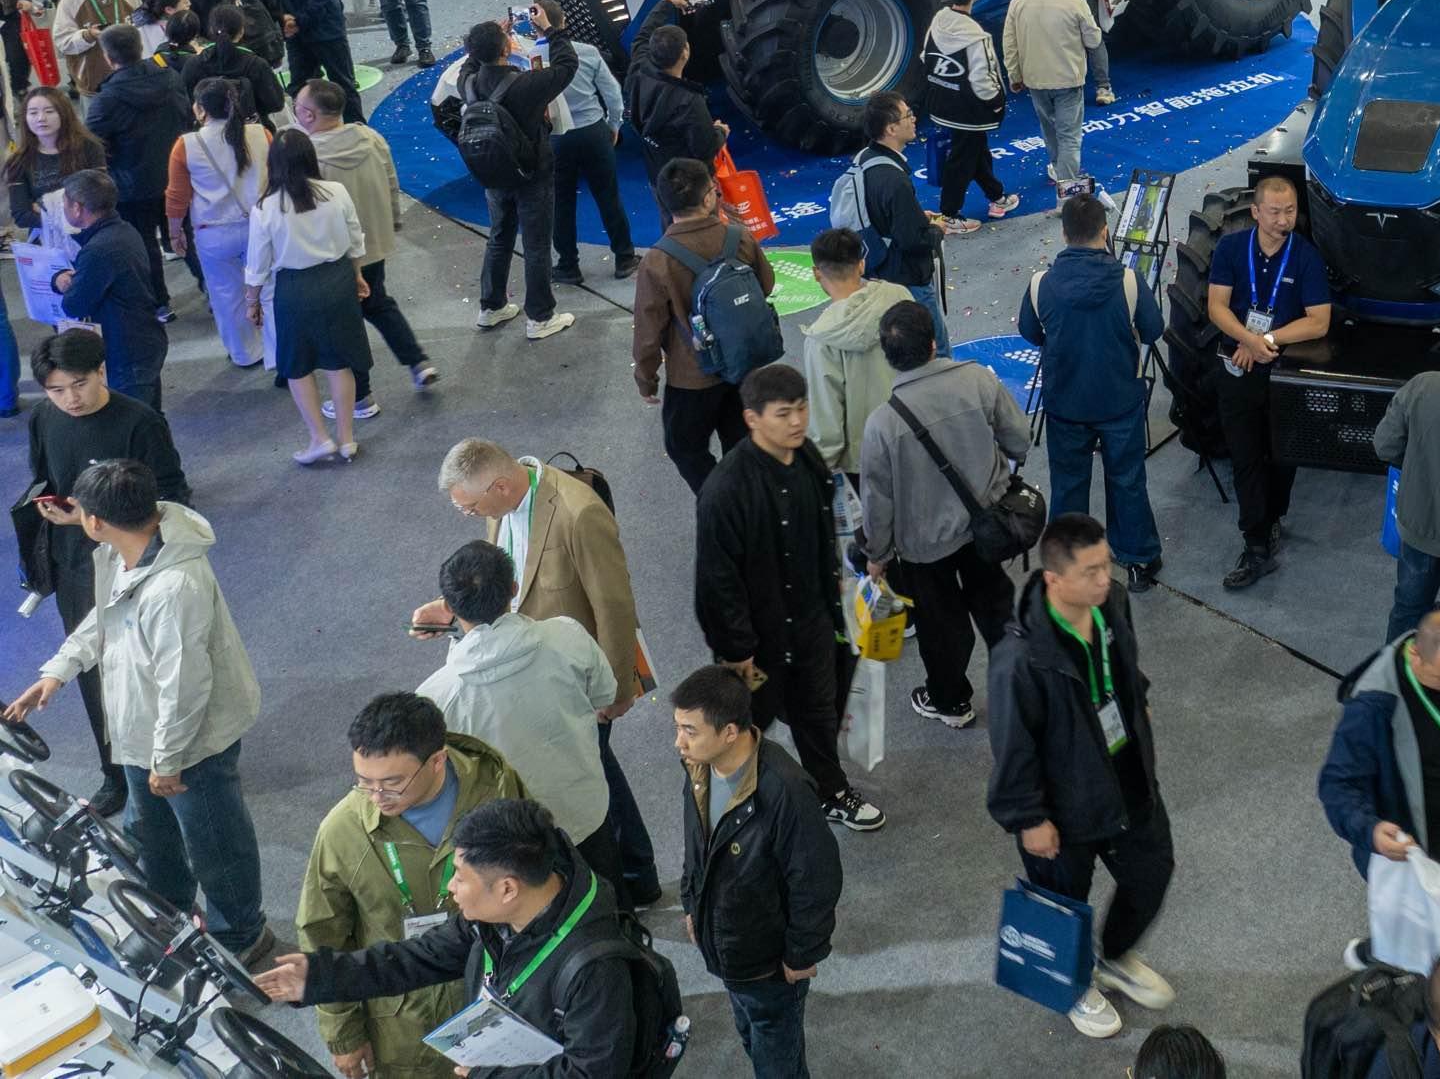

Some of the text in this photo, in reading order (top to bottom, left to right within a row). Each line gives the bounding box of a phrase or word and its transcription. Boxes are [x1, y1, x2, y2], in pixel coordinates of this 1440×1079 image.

[1010, 70, 1285, 154] 醇动力智能拖拉机
